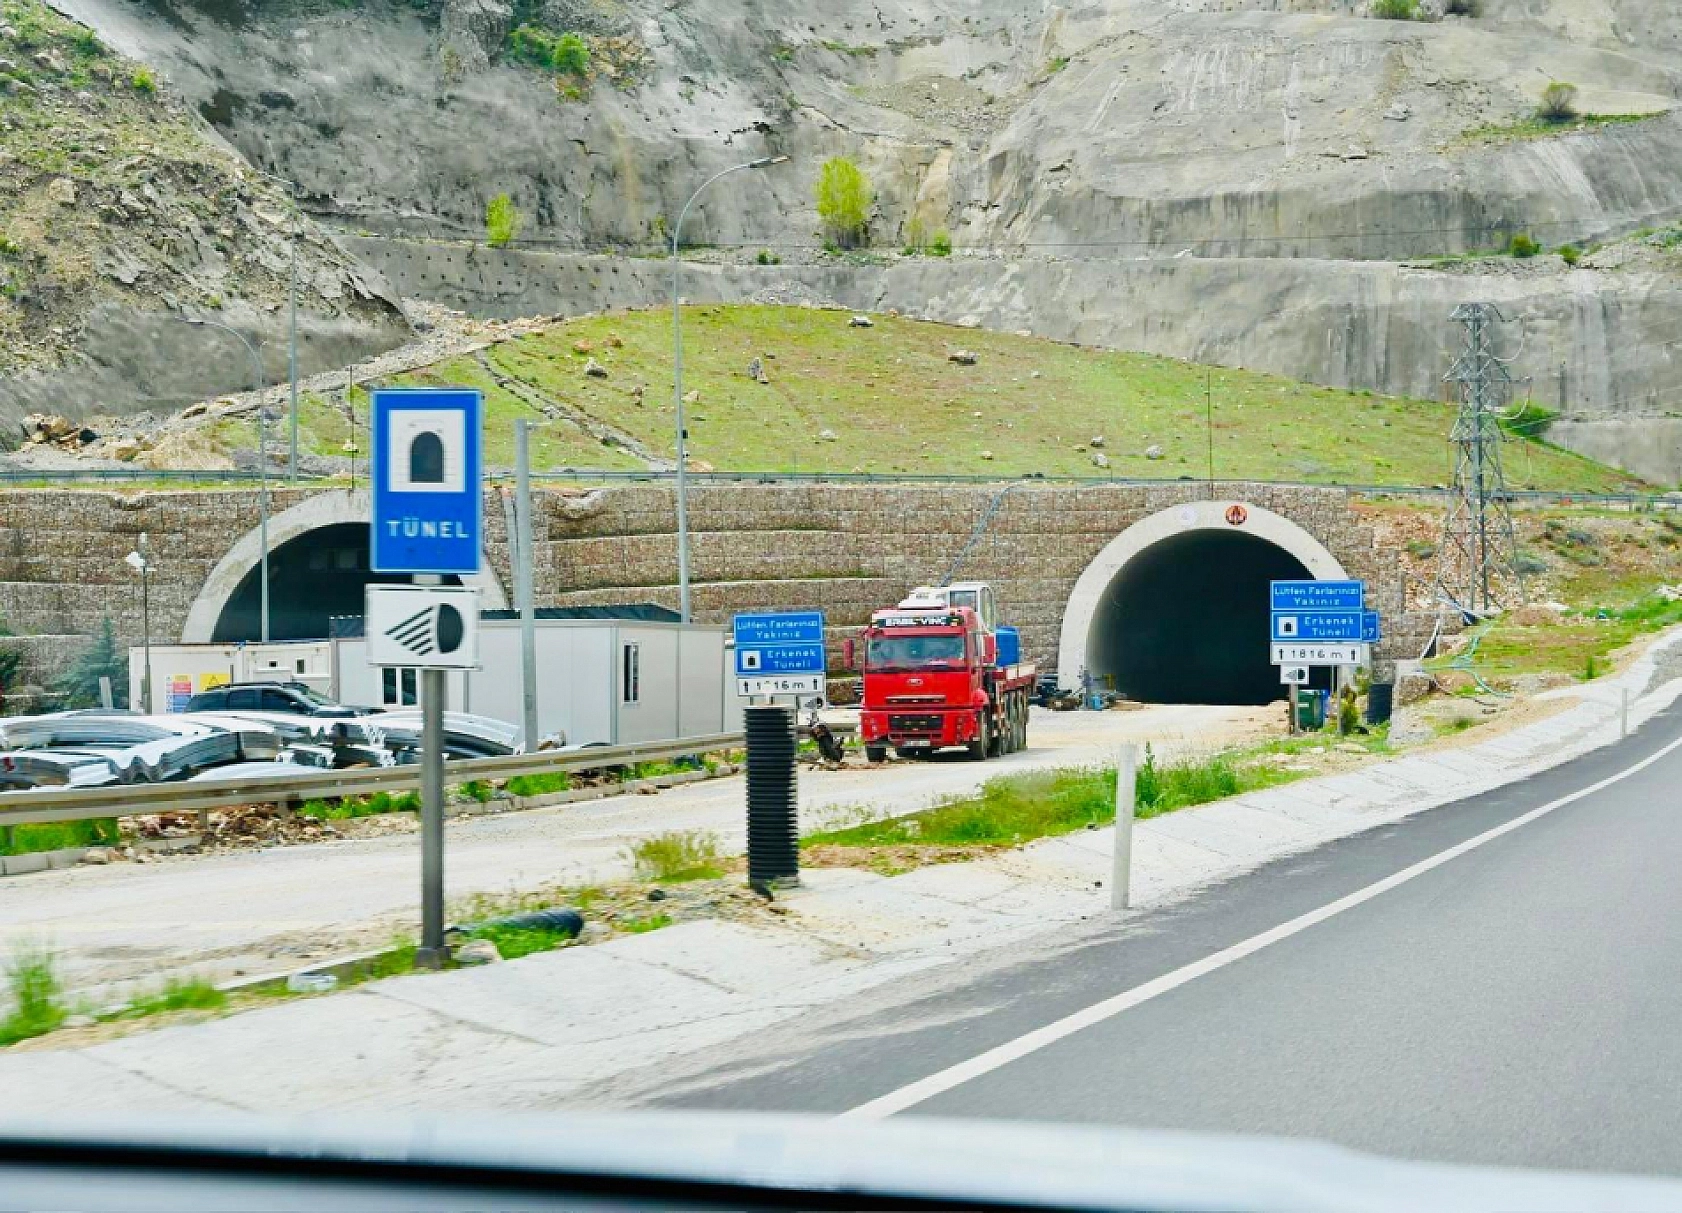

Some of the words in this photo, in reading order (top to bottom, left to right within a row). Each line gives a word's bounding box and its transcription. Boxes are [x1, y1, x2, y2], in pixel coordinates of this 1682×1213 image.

[386, 516, 470, 539] TÜNEL
[1304, 616, 1355, 626] Erkenek
[767, 648, 816, 659] Erkenek
[1291, 648, 1326, 659] 1816
[1330, 650, 1344, 659] m
[792, 681, 806, 690] m
